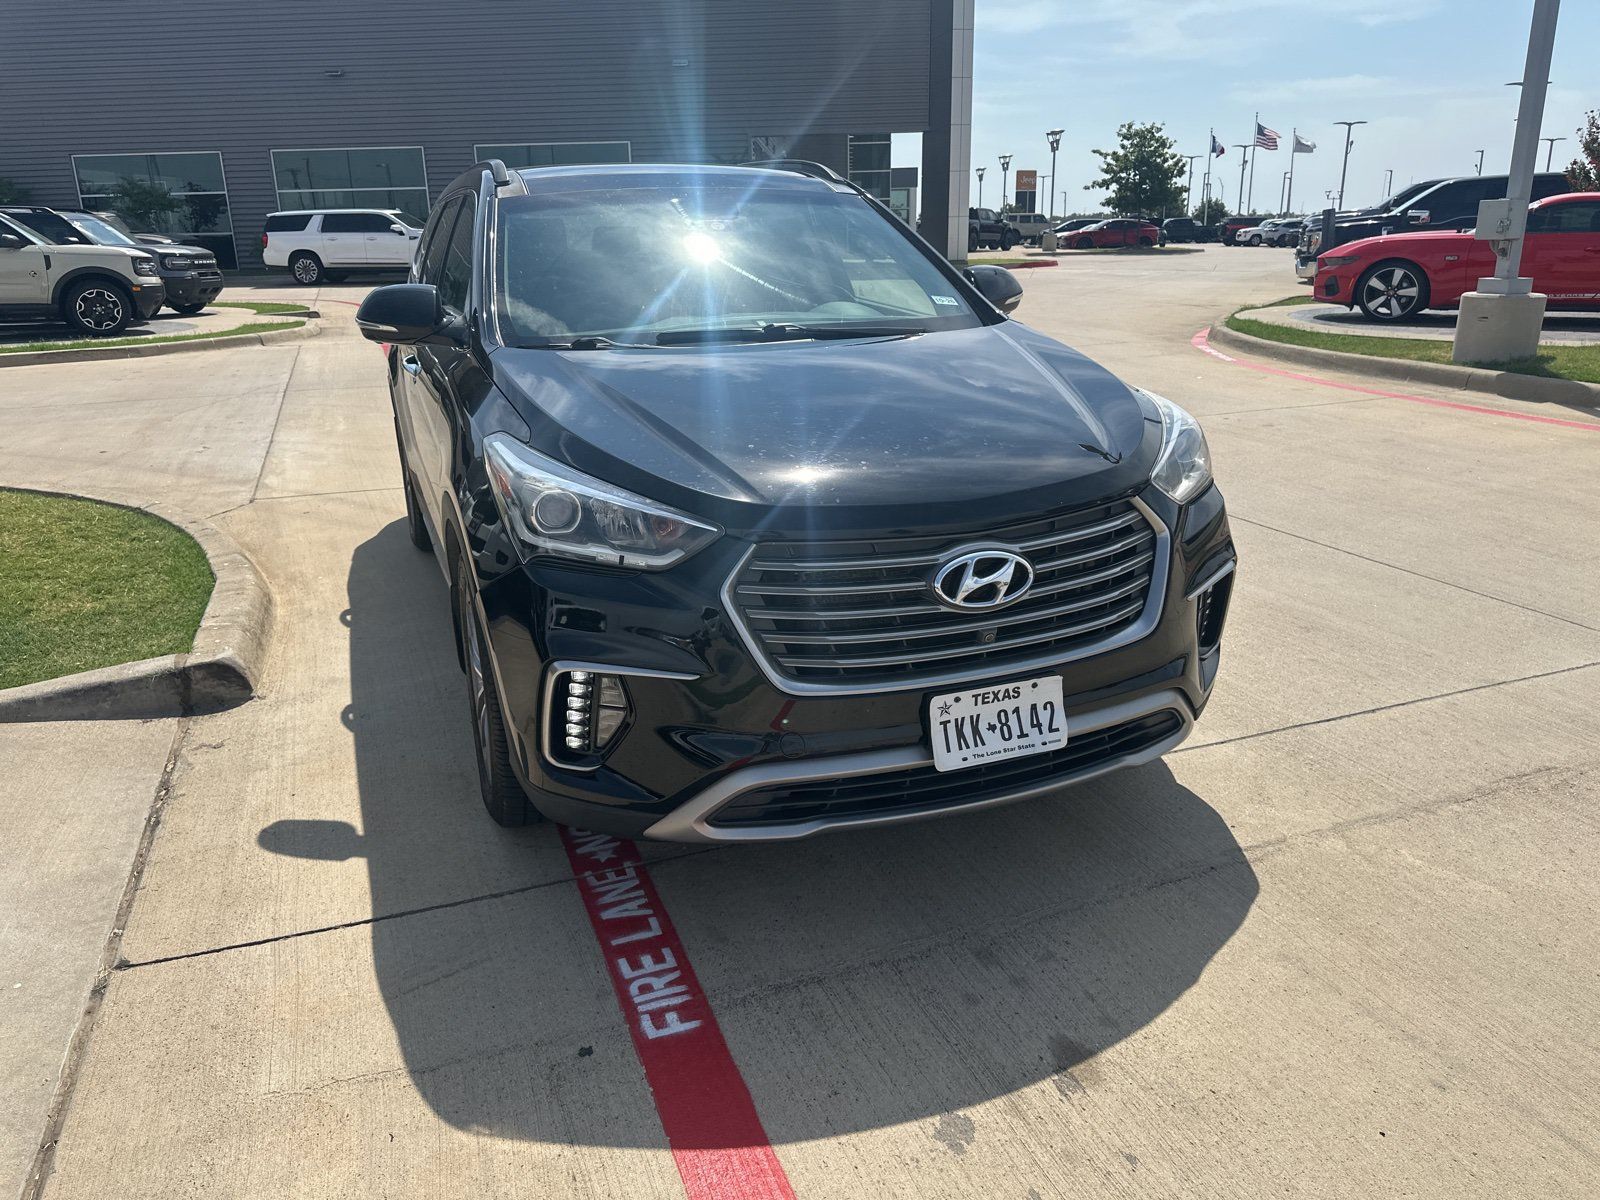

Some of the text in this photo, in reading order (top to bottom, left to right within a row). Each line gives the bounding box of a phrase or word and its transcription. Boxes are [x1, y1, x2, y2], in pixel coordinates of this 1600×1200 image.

[1020, 175, 1036, 184] Jeep
[972, 686, 1021, 706] TEXAS
[940, 701, 1060, 754] TKK 8142
[986, 749, 1002, 757] Lone
[1017, 743, 1036, 751] State
[568, 827, 703, 1040] FIRE LANE N
